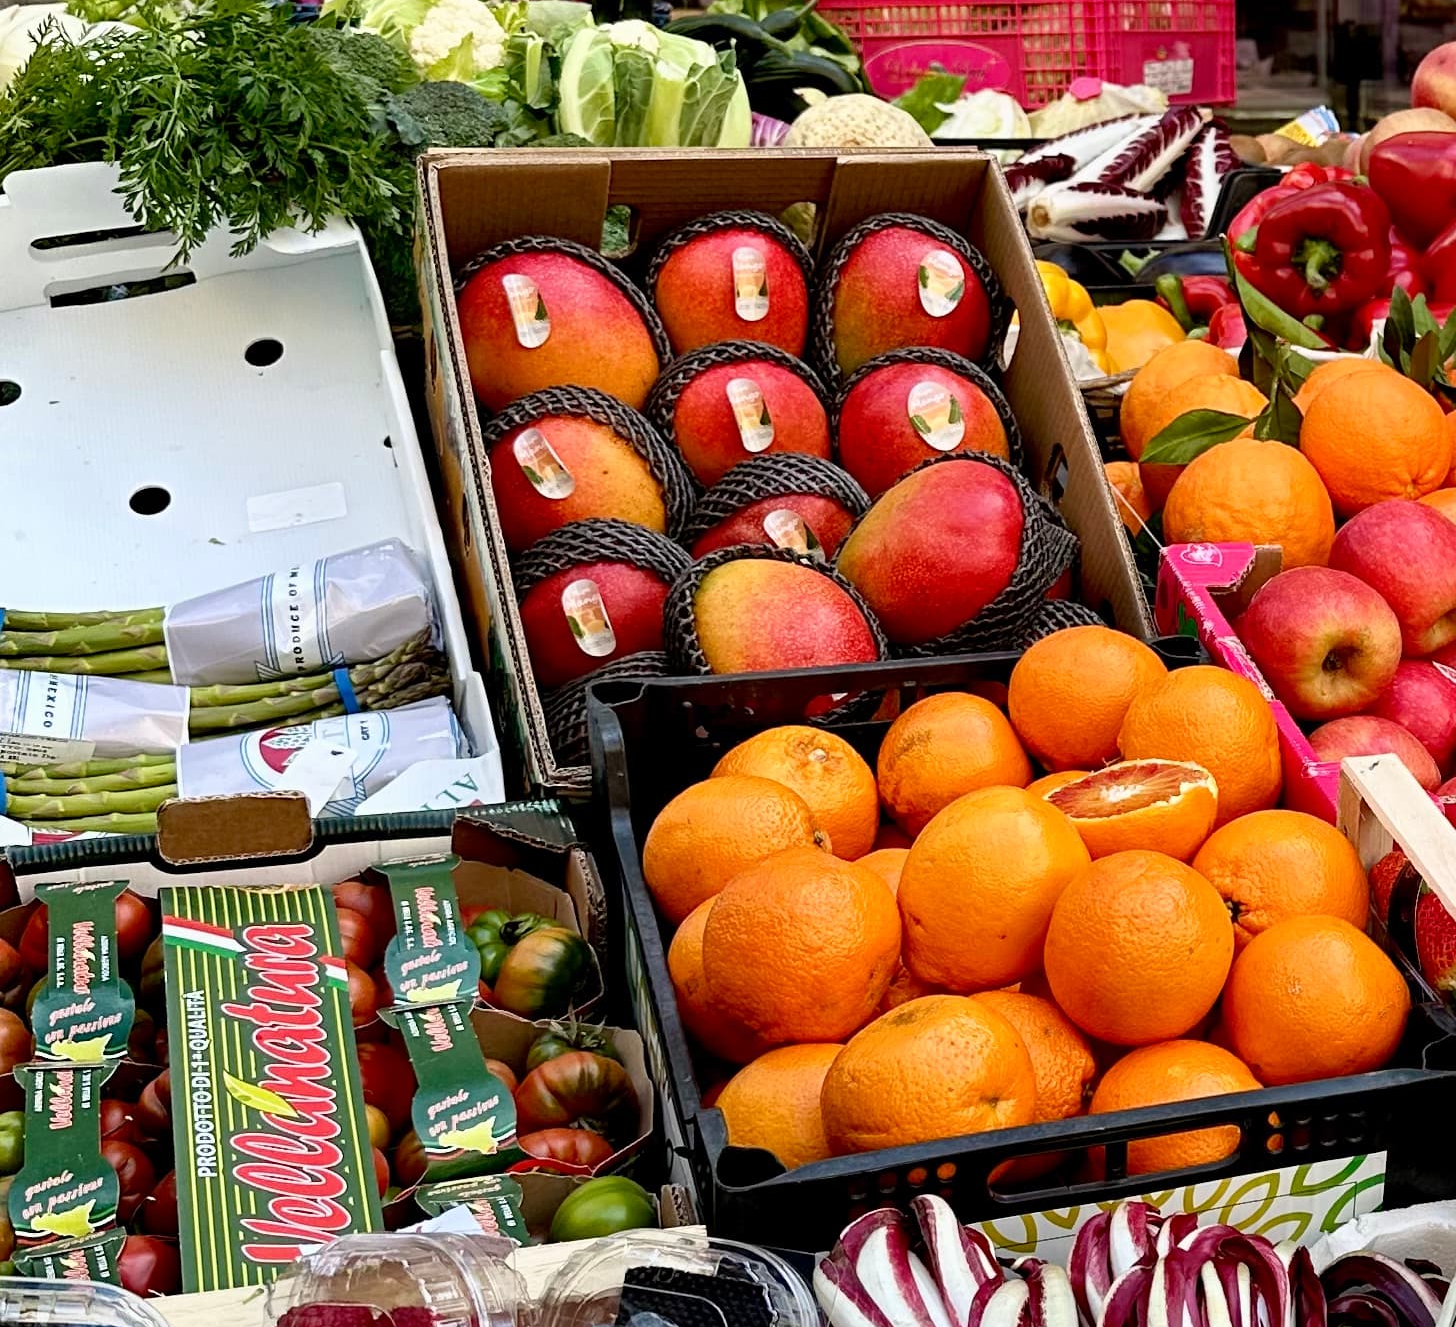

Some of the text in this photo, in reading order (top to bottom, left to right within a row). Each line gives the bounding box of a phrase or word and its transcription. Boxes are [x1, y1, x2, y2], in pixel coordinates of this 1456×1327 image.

[181, 990, 212, 1052] QUALITÀ
[191, 1072, 211, 1088] DI
[221, 923, 351, 1264] Vellanatura
[192, 1090, 218, 1178] PRODOTTO
